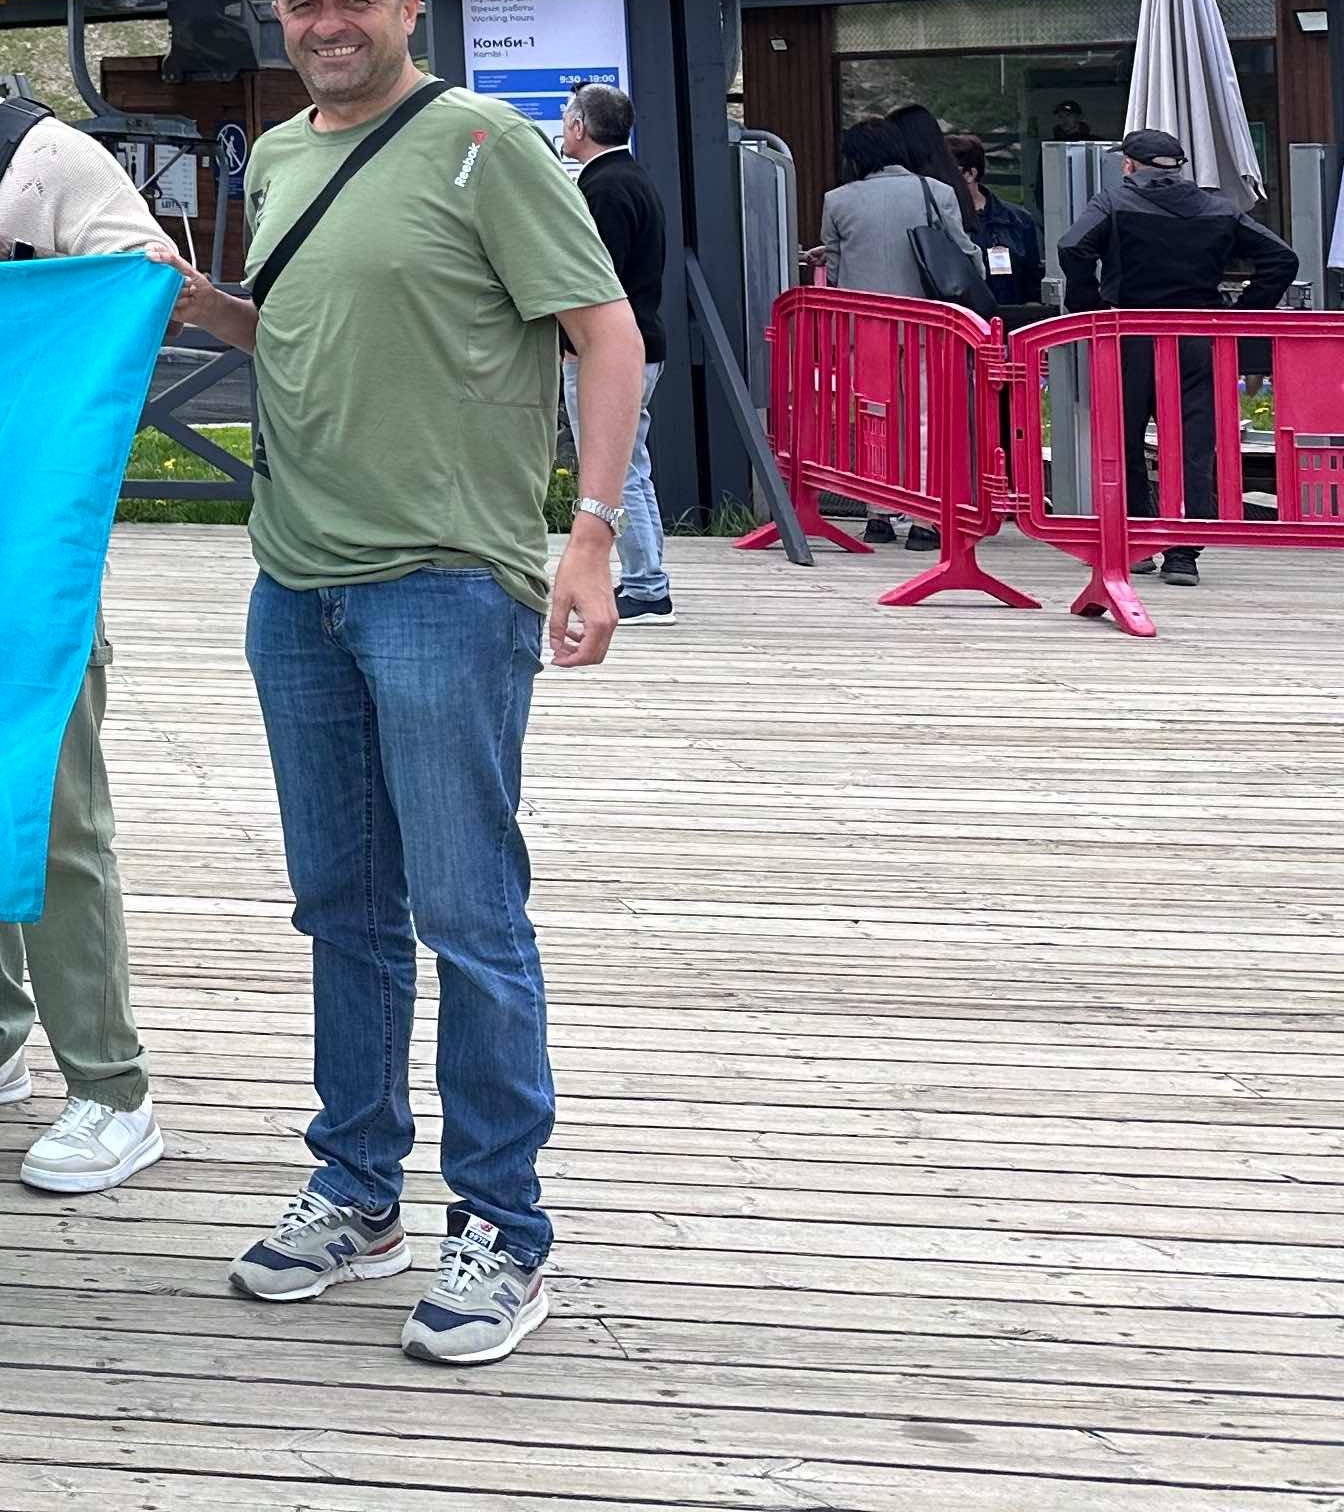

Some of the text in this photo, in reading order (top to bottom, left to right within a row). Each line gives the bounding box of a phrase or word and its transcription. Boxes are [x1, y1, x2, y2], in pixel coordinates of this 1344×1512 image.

[472, 15, 508, 23] Working
[473, 36, 535, 49] Комби-1
[454, 142, 481, 188] Reebok
